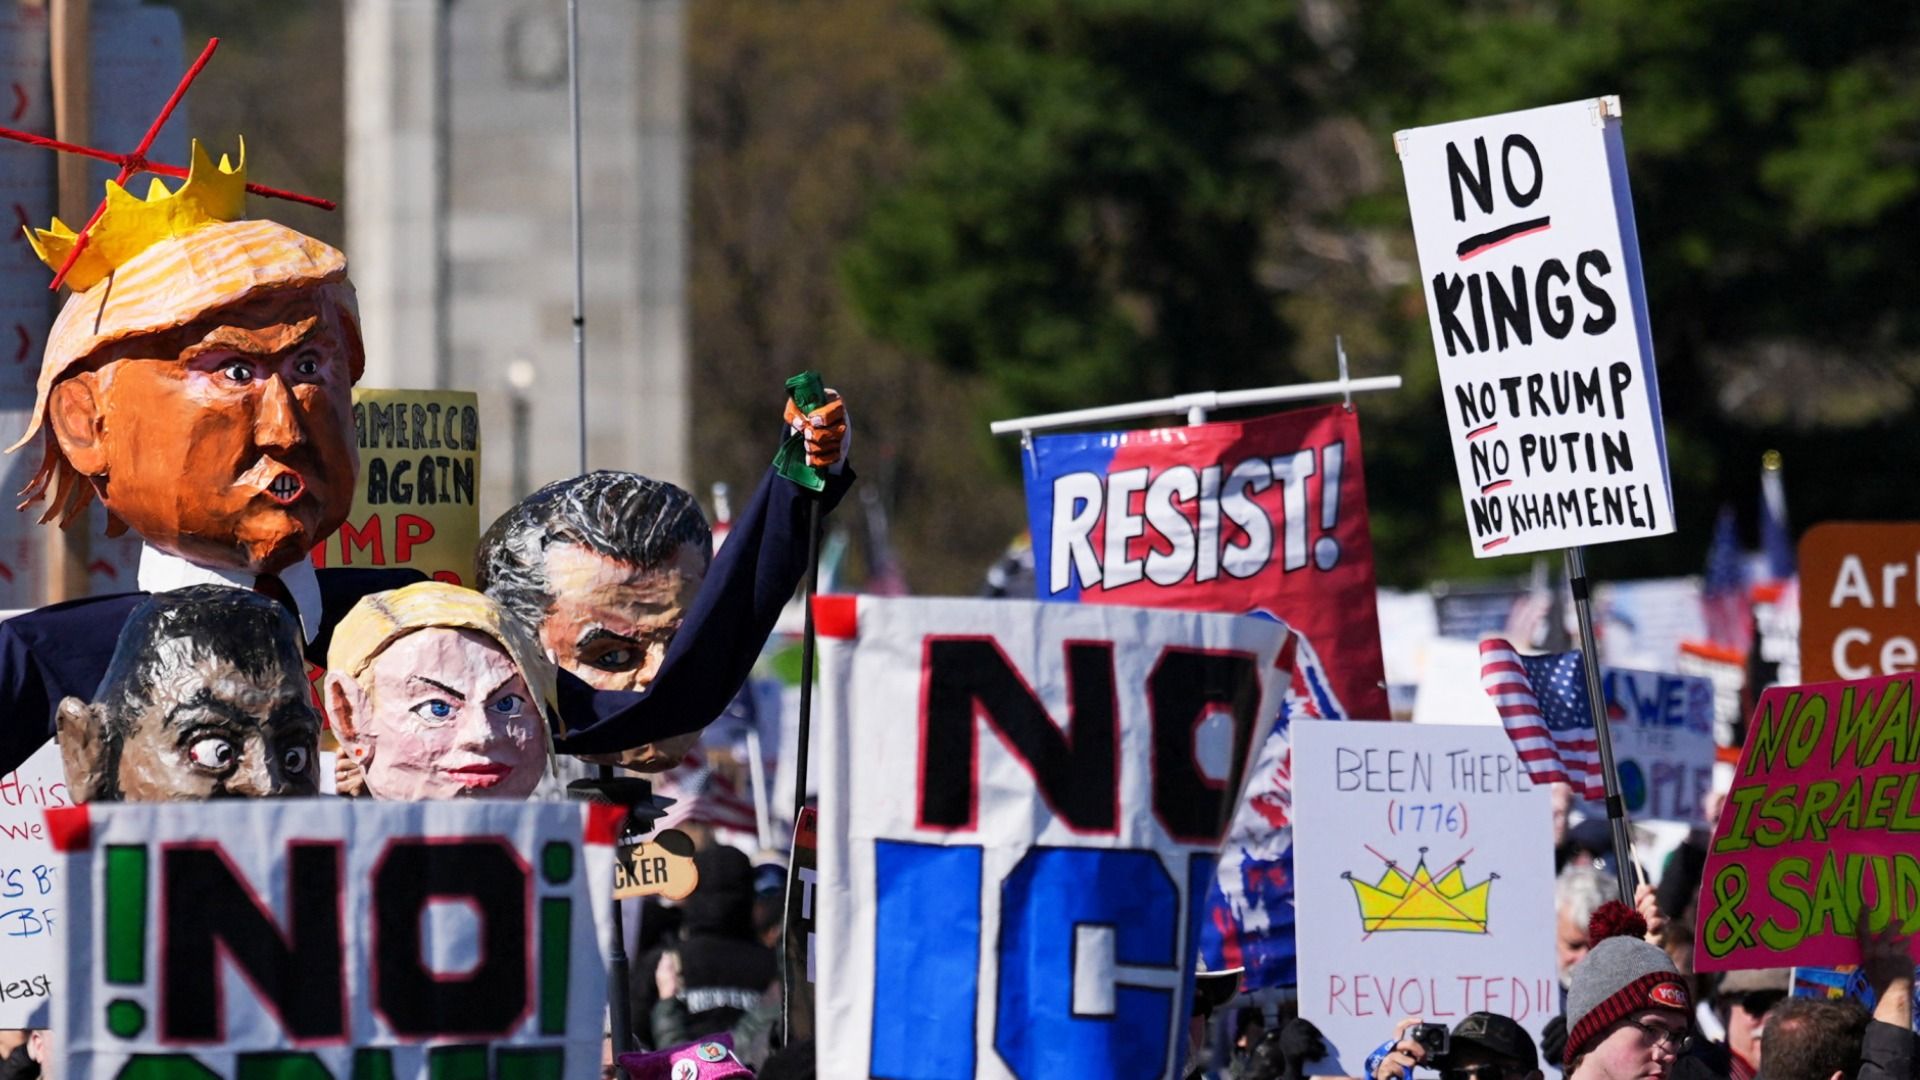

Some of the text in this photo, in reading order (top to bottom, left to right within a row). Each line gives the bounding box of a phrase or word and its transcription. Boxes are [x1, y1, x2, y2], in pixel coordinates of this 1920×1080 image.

[1446, 133, 1543, 222] NO
[1432, 249, 1617, 357] KINGS
[1455, 361, 1632, 428] NO TRUMP
[367, 455, 474, 505] AGAIN
[1470, 430, 1633, 487] NO PUTIN
[311, 513, 435, 569] MP
[1049, 441, 1344, 595] RESIST!
[1471, 484, 1655, 537] NO KHAMENEI
[1832, 627, 1918, 680] Ce
[913, 634, 1262, 846] NO
[1744, 692, 1828, 777] NO
[1336, 747, 1532, 793] BEEN THERE
[1388, 799, 1468, 839] (1776)
[1714, 772, 1920, 853] ISRAEL
[32, 864, 56, 895] B
[1703, 863, 1757, 958] &
[868, 838, 1222, 1080] IC
